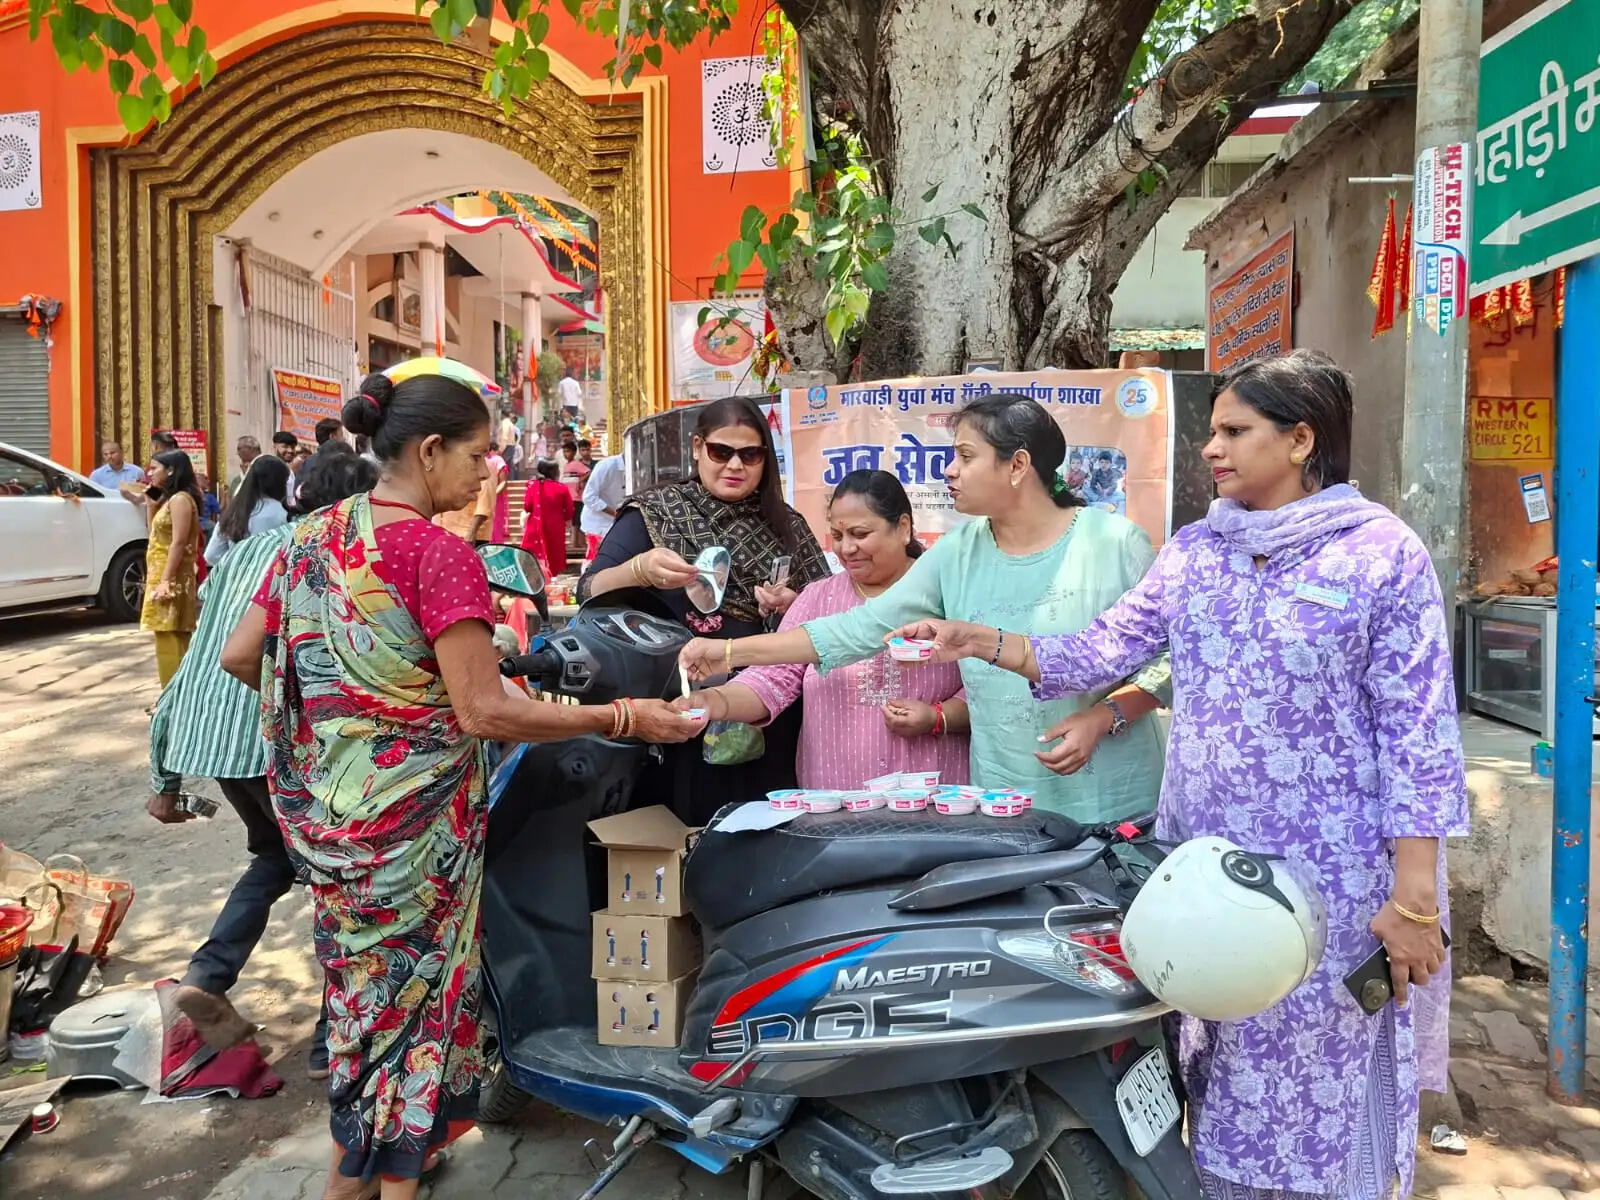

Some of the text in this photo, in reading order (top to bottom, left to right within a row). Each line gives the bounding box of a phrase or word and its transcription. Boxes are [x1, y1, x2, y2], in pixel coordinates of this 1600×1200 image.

[1445, 144, 1463, 241] HI-TECH
[1427, 255, 1438, 289] PHP
[1441, 260, 1453, 293] DCA
[840, 384, 893, 411] मारवाड़ी
[898, 387, 927, 411] युवा
[931, 384, 955, 405] मंच
[1058, 387, 1102, 405] शाखा
[1127, 388, 1148, 404] 25
[1474, 419, 1529, 432] WESTERN
[895, 432, 955, 485] सेव
[1475, 432, 1543, 455] CIRCLE 521
[835, 959, 992, 991] MAESTRO
[706, 990, 954, 1056] EDGE
